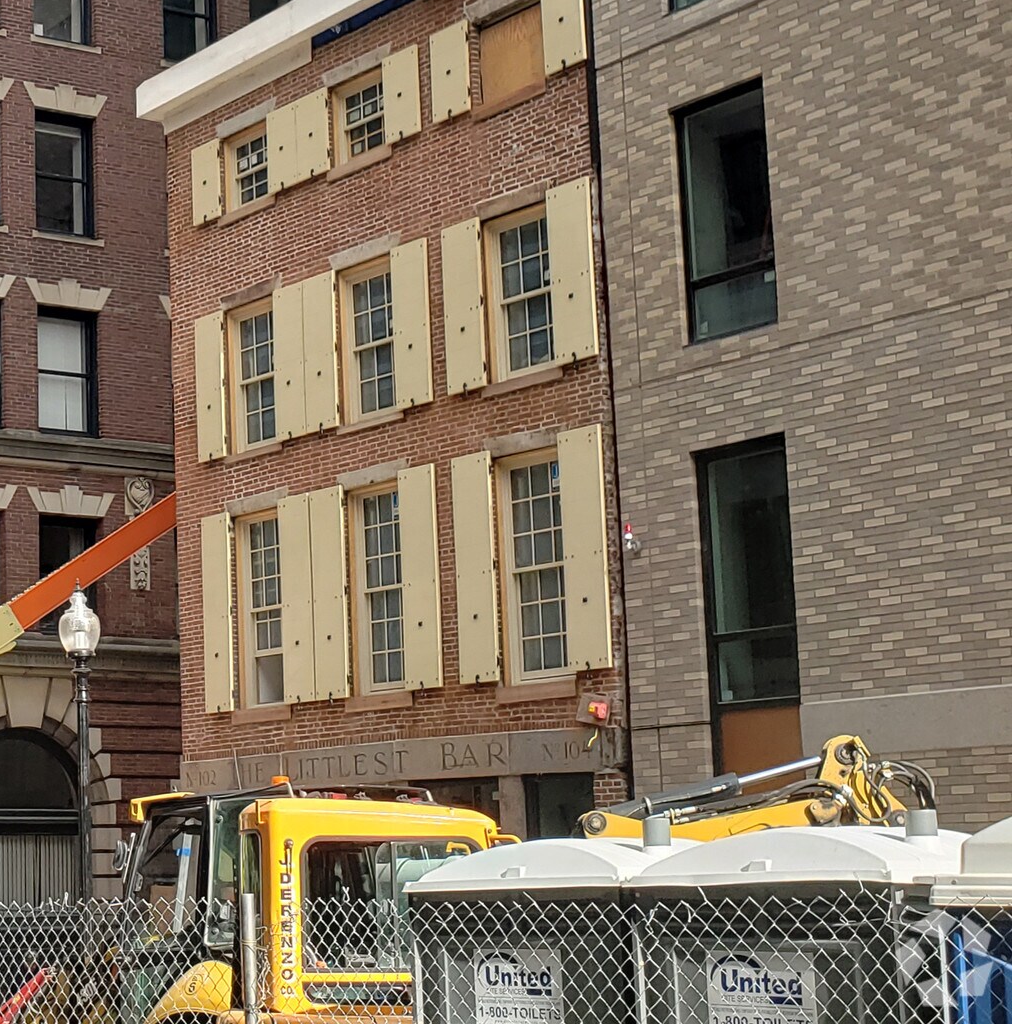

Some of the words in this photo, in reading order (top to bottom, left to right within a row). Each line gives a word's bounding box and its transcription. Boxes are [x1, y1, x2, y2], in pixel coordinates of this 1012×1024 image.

[284, 750, 410, 781] LITTLEST
[440, 742, 507, 770] BAR
[485, 965, 552, 987] United
[720, 969, 803, 995] United
[478, 1006, 561, 1020] 1-800-TOILETS
